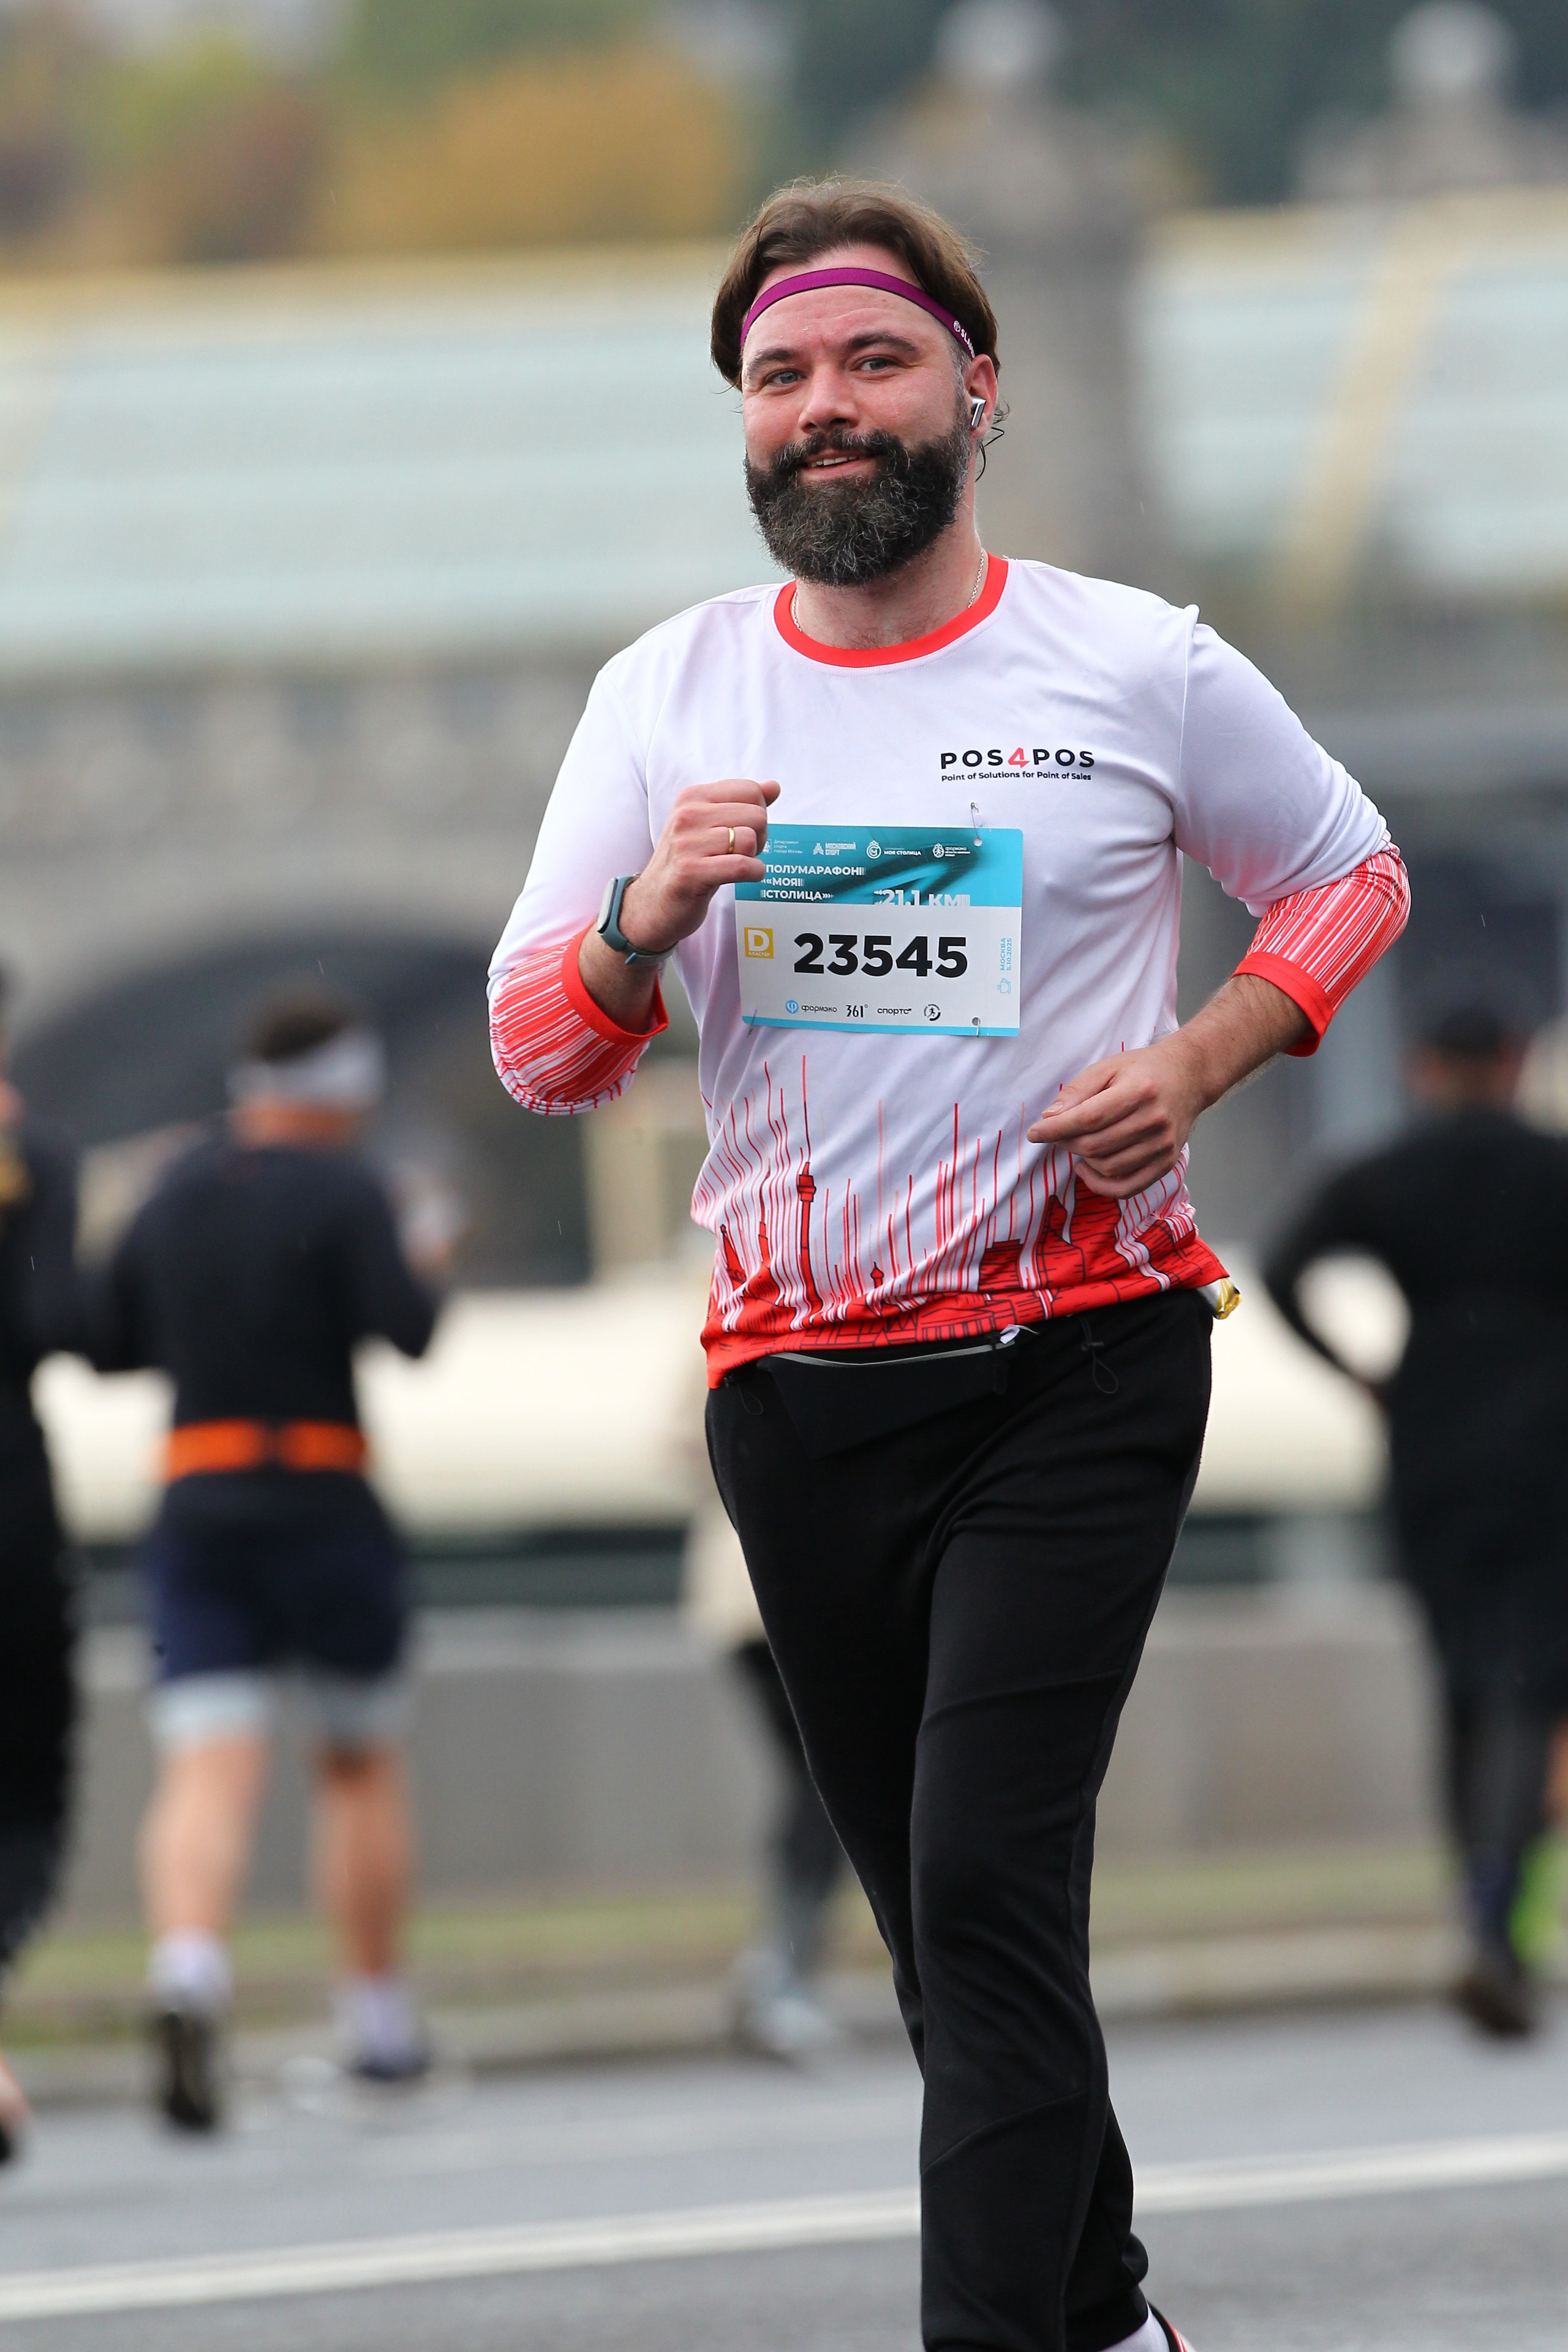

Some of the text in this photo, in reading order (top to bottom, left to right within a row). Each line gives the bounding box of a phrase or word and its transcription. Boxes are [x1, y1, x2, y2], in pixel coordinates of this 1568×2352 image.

[940, 747, 1095, 769] POS4POS
[978, 771, 1020, 779] Solutions
[766, 864, 861, 876] ПОЛУМАРАФОН
[883, 889, 921, 906] 21.1
[747, 929, 770, 951] D
[794, 932, 968, 978] 23545
